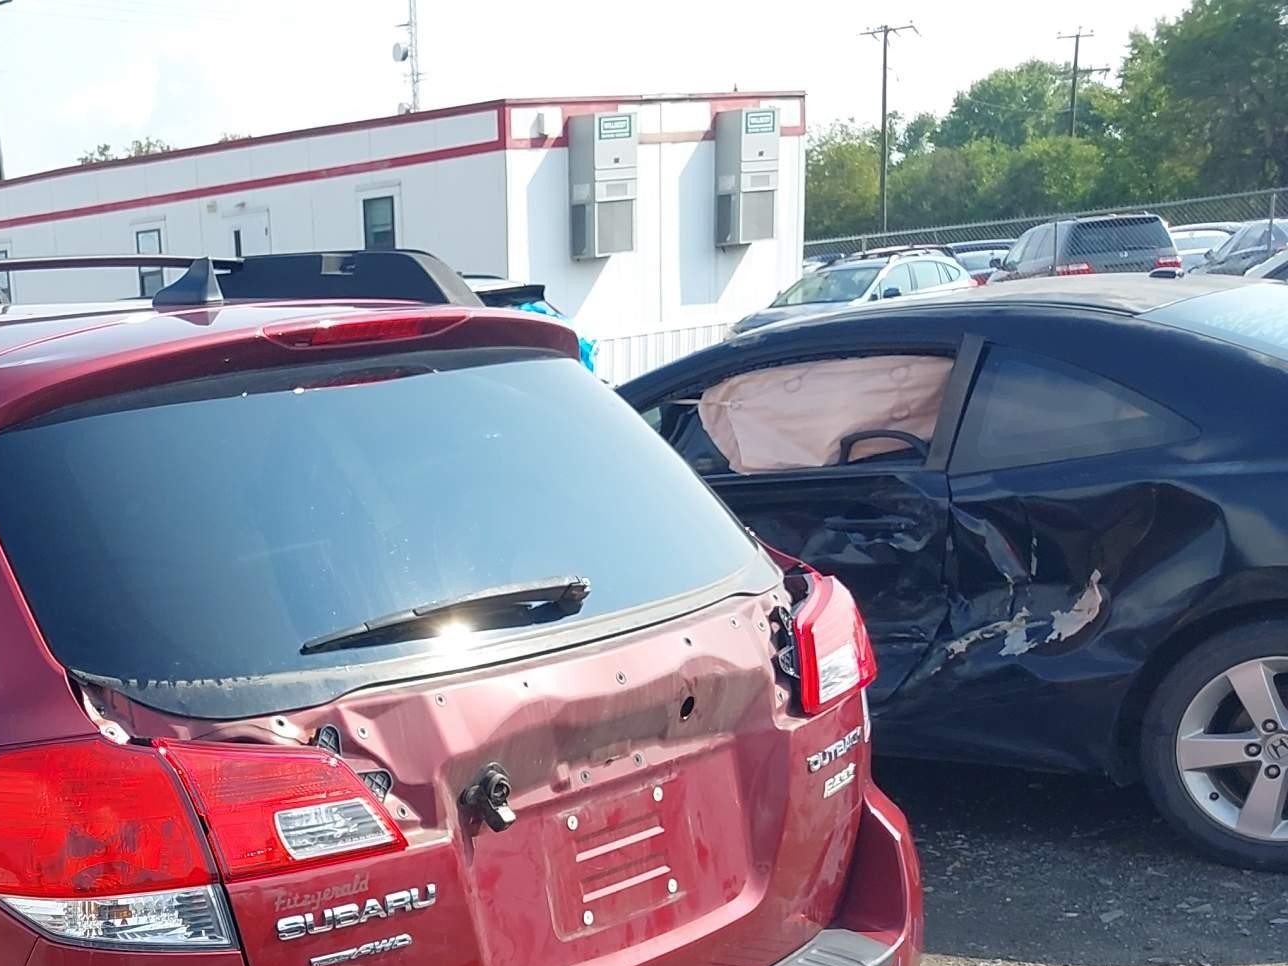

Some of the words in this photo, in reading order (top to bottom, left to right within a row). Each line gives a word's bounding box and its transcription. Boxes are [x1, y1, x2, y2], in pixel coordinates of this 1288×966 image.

[274, 872, 370, 912] Fitzgerald
[276, 883, 437, 941] SUBARU
[350, 933, 413, 960] AWD
